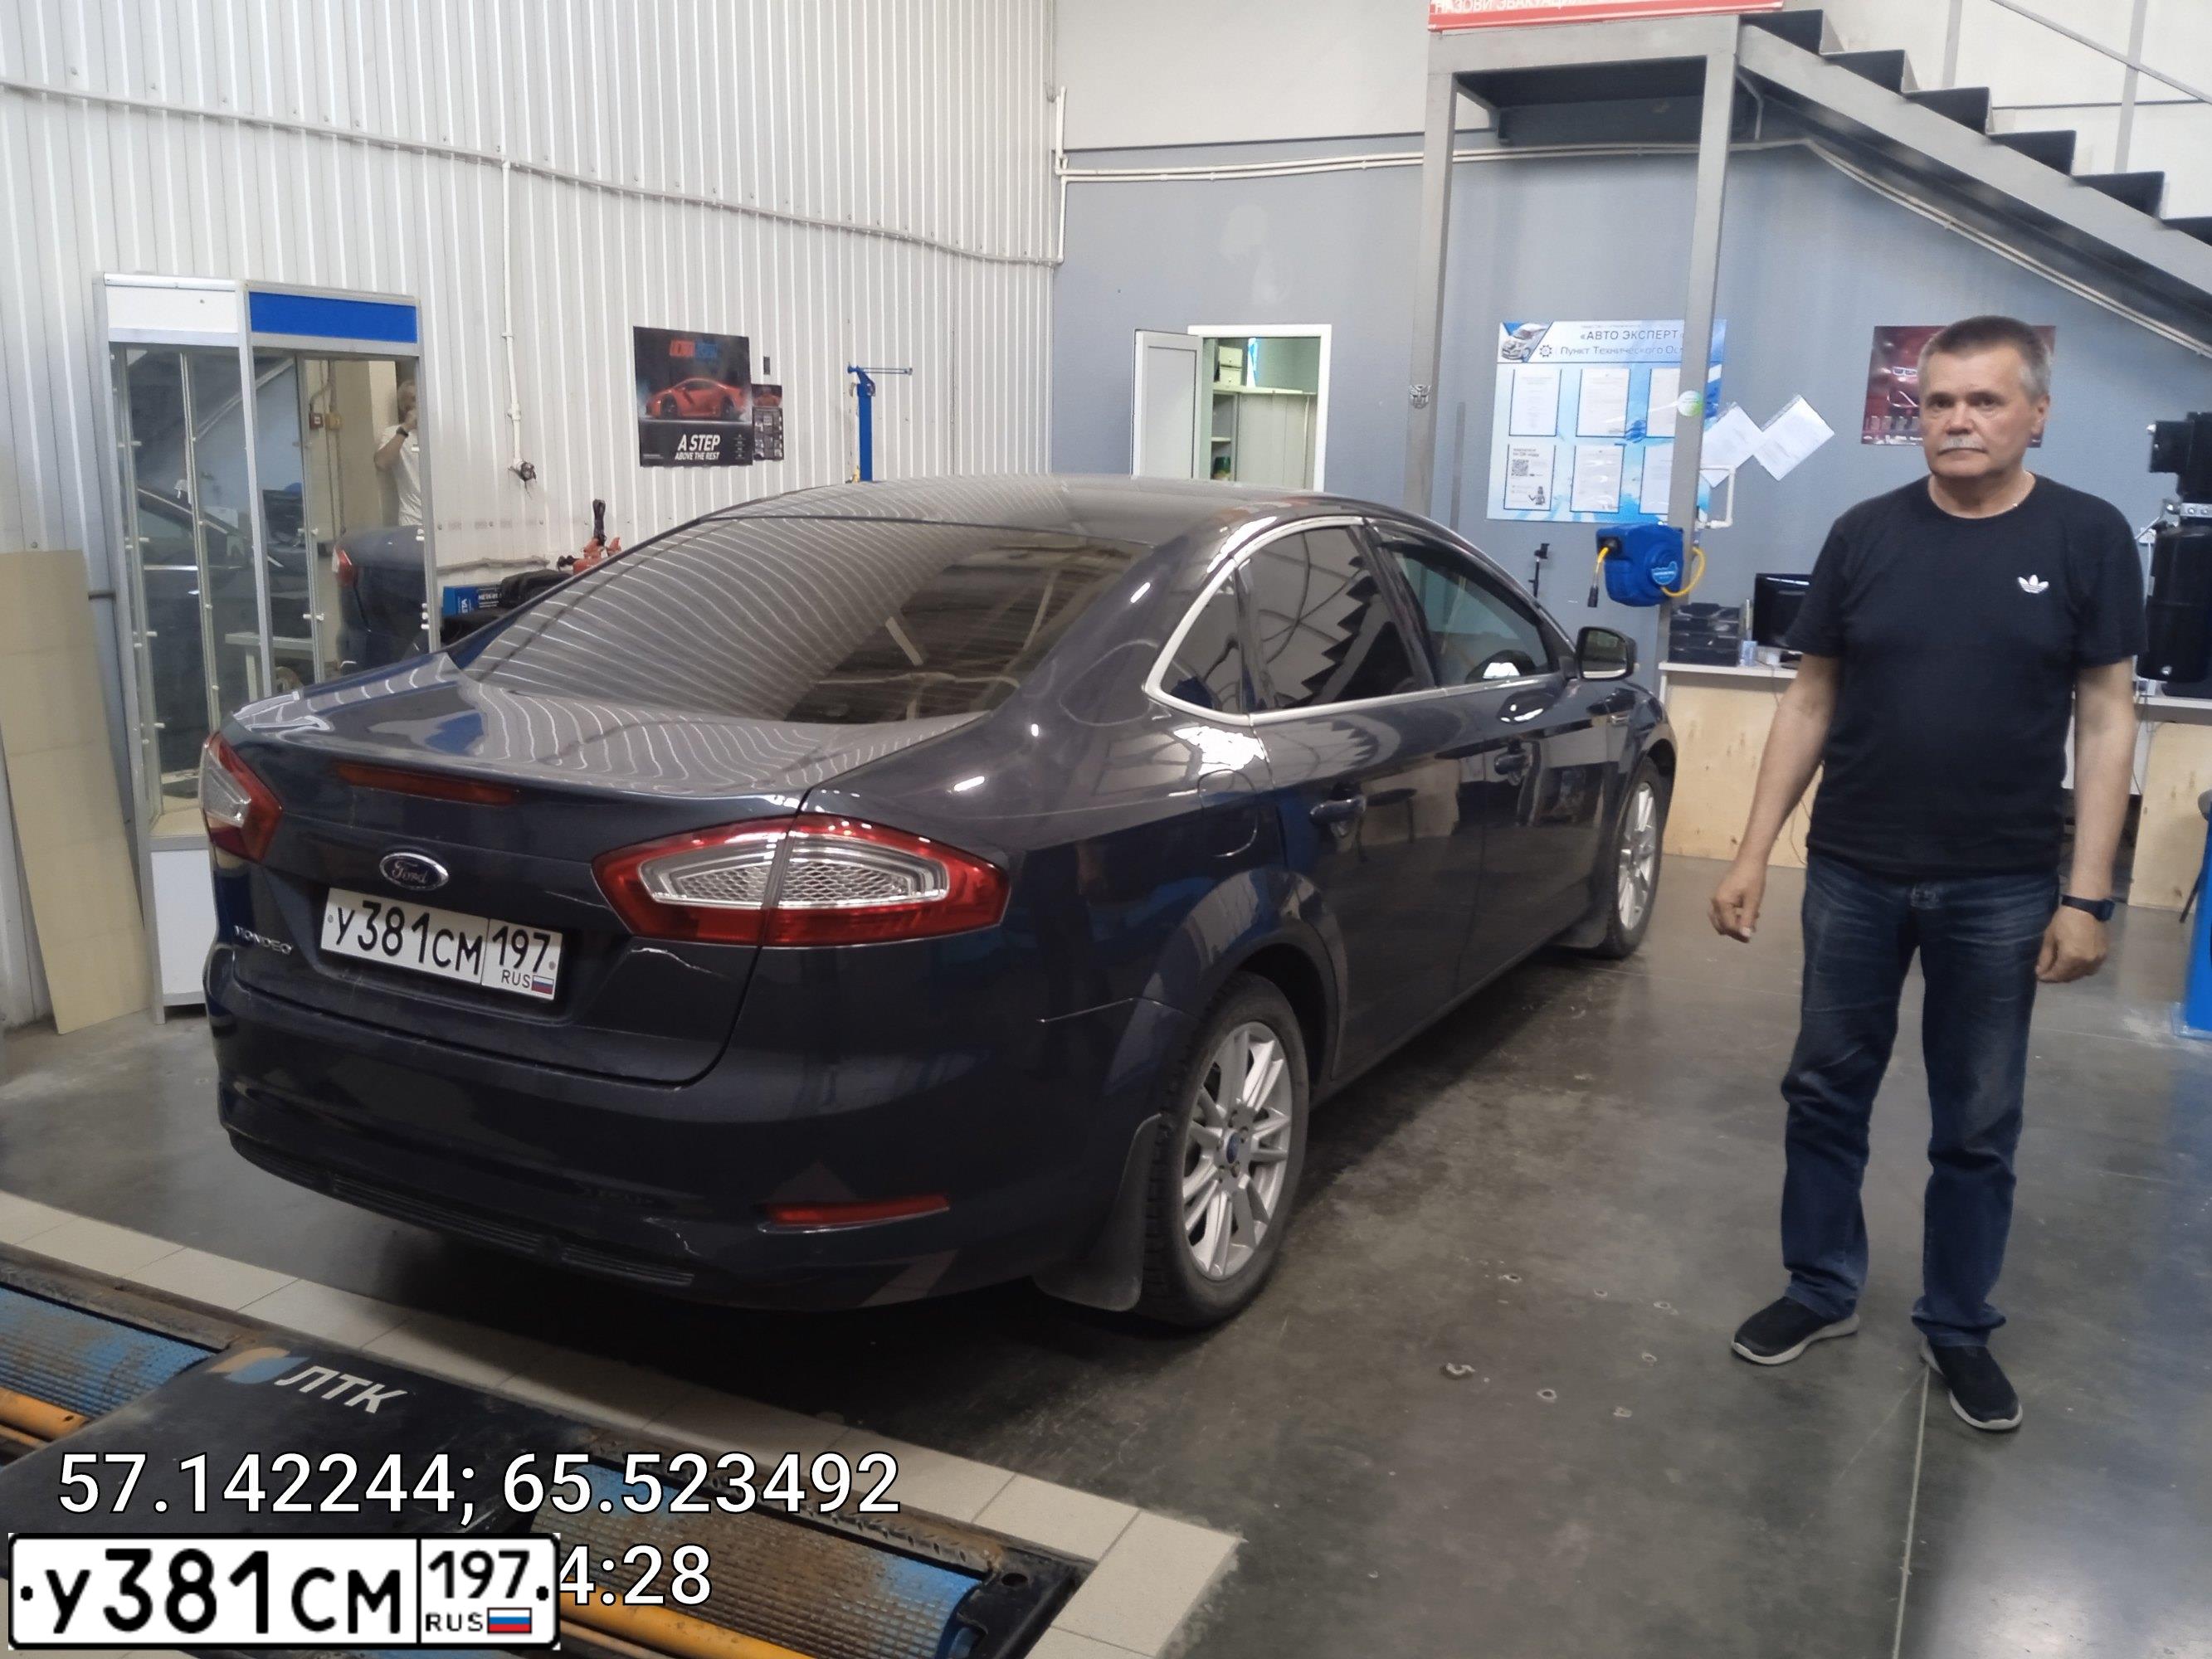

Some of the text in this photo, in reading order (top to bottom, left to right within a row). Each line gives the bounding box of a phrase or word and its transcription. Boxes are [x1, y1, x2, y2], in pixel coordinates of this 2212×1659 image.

[1580, 330, 1619, 340] «АВТО
[1560, 346, 1591, 357] Пункт
[677, 434, 688, 451] A
[689, 434, 721, 451] STEP
[675, 451, 694, 460] ABOVE
[694, 451, 705, 460] THE
[705, 451, 720, 460] REST
[392, 860, 428, 884] Ford
[337, 900, 551, 975] У381СМ 197
[501, 969, 531, 989] RUS
[274, 1365, 408, 1414] ЛТК
